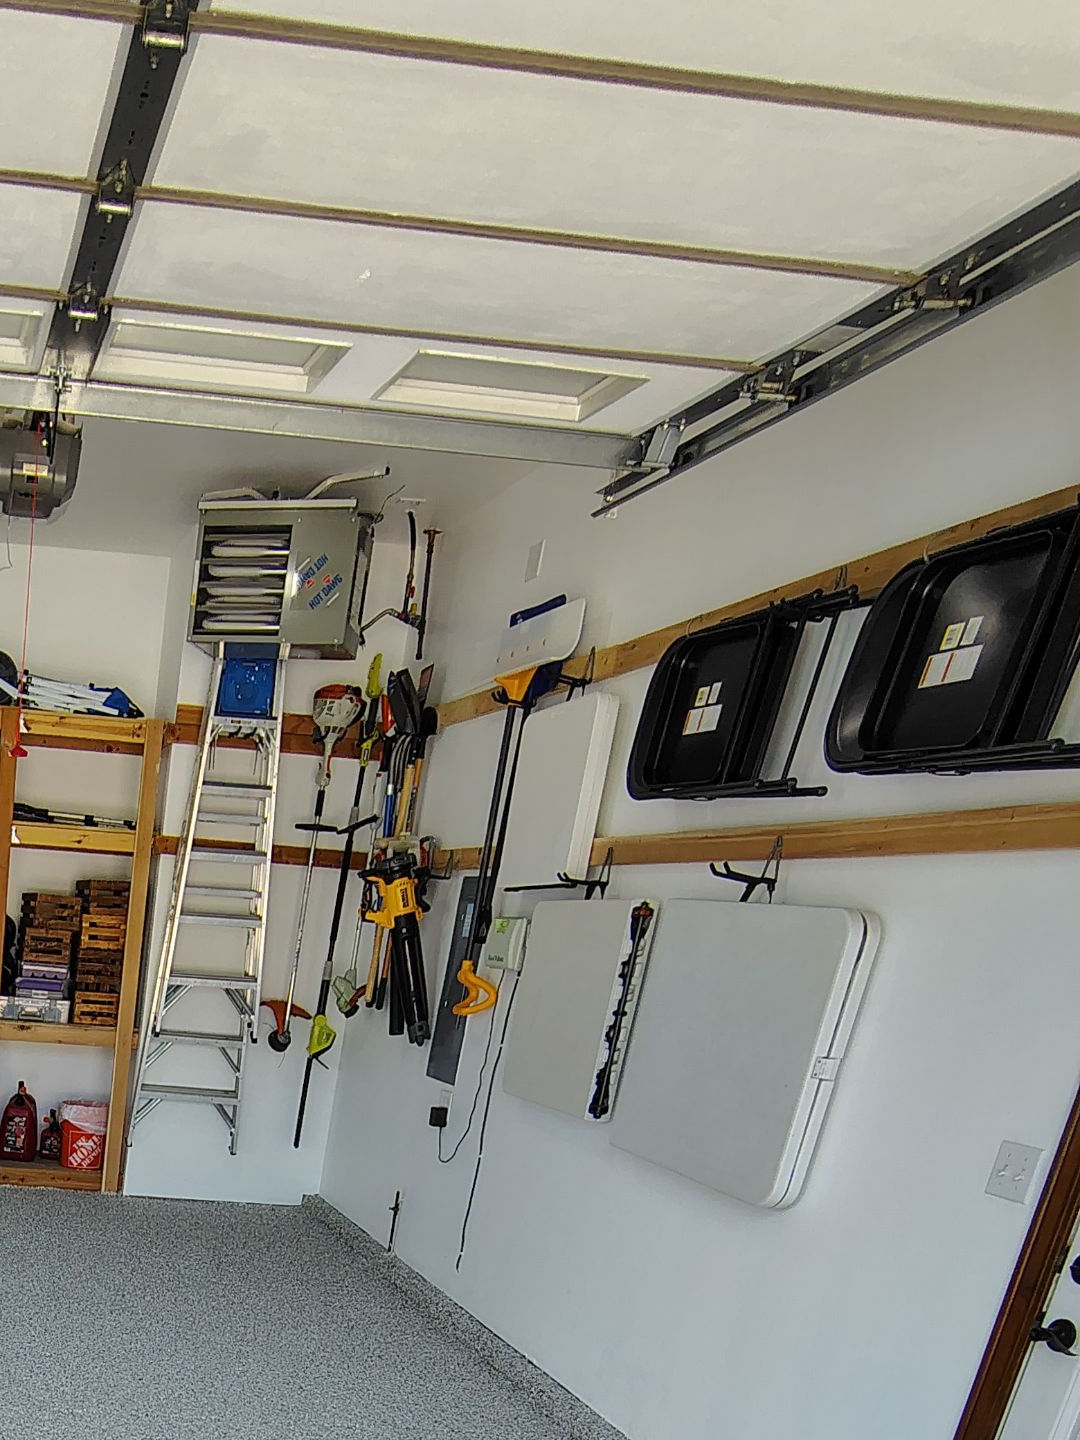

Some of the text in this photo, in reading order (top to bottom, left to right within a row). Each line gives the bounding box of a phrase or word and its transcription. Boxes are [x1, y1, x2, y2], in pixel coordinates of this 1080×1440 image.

[314, 553, 329, 571] HOT
[309, 574, 343, 610] HOT DAWG
[67, 1135, 103, 1167] HOME
[72, 1135, 86, 1150] THE
